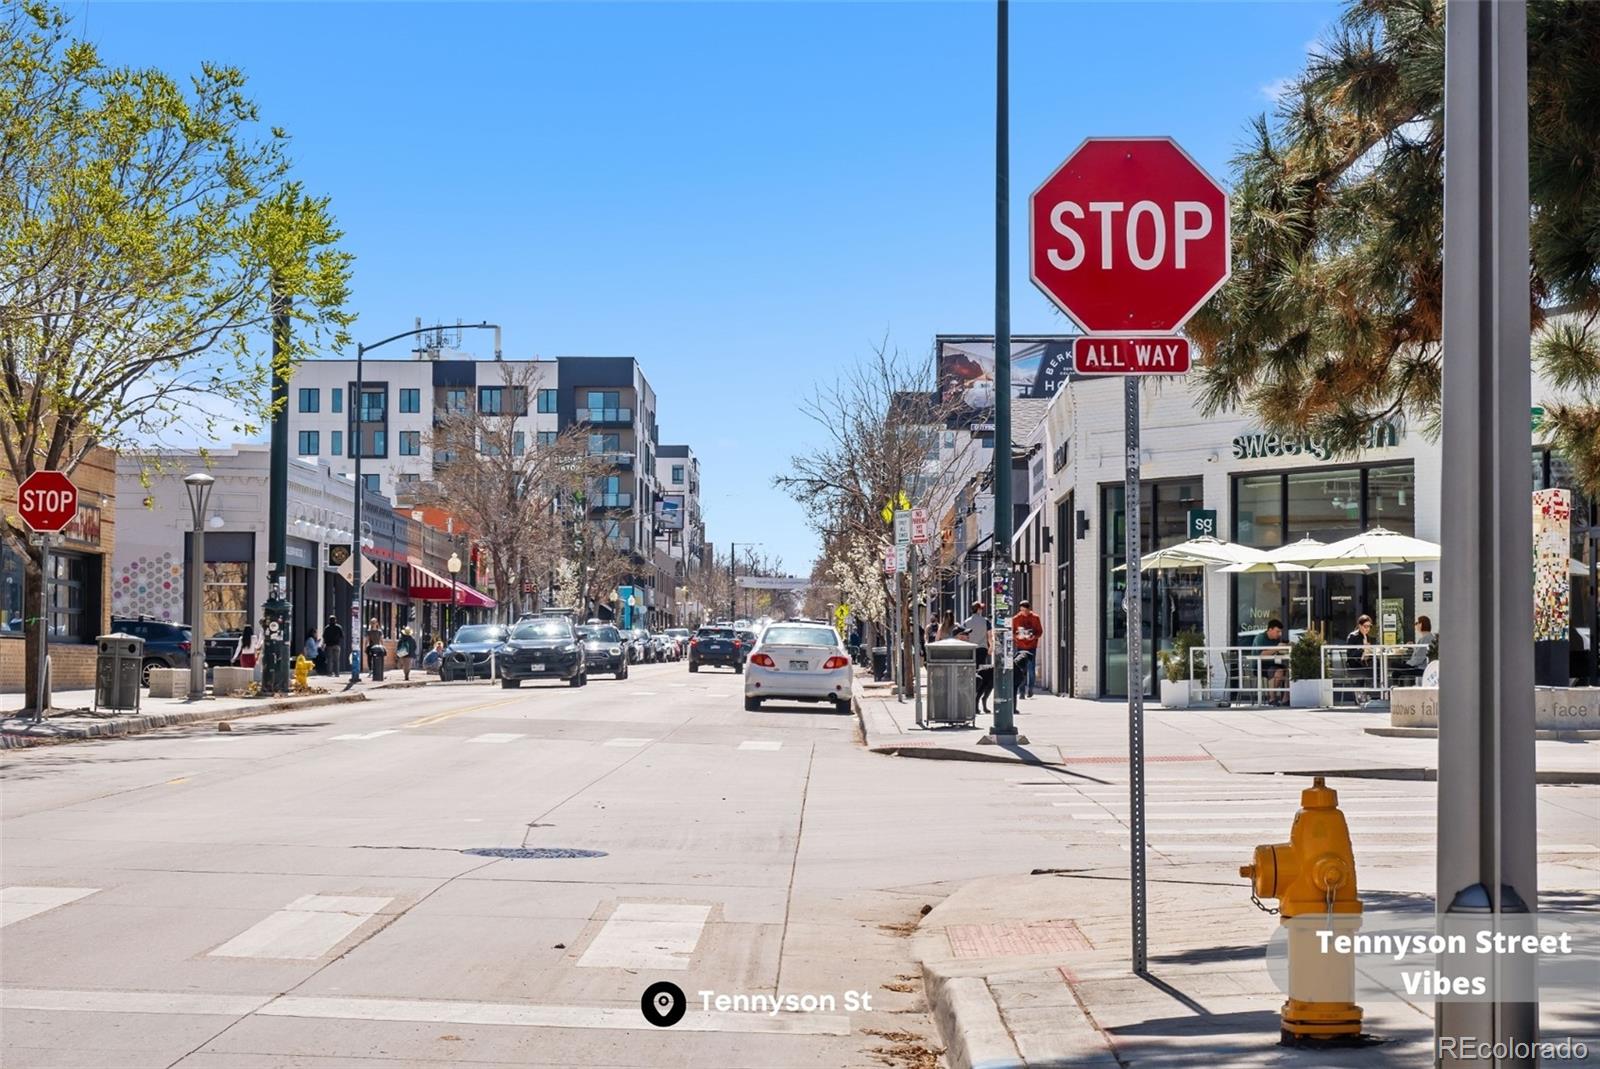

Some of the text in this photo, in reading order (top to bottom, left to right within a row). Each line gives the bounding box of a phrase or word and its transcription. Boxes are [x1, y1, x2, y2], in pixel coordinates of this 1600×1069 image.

[1047, 200, 1213, 271] STOP
[1085, 344, 1179, 367] ALL WAY
[22, 489, 73, 512] STOP
[1195, 518, 1213, 533] sg
[1249, 608, 1271, 619] Now
[1240, 622, 1268, 633] Servi
[1552, 702, 1588, 717] face
